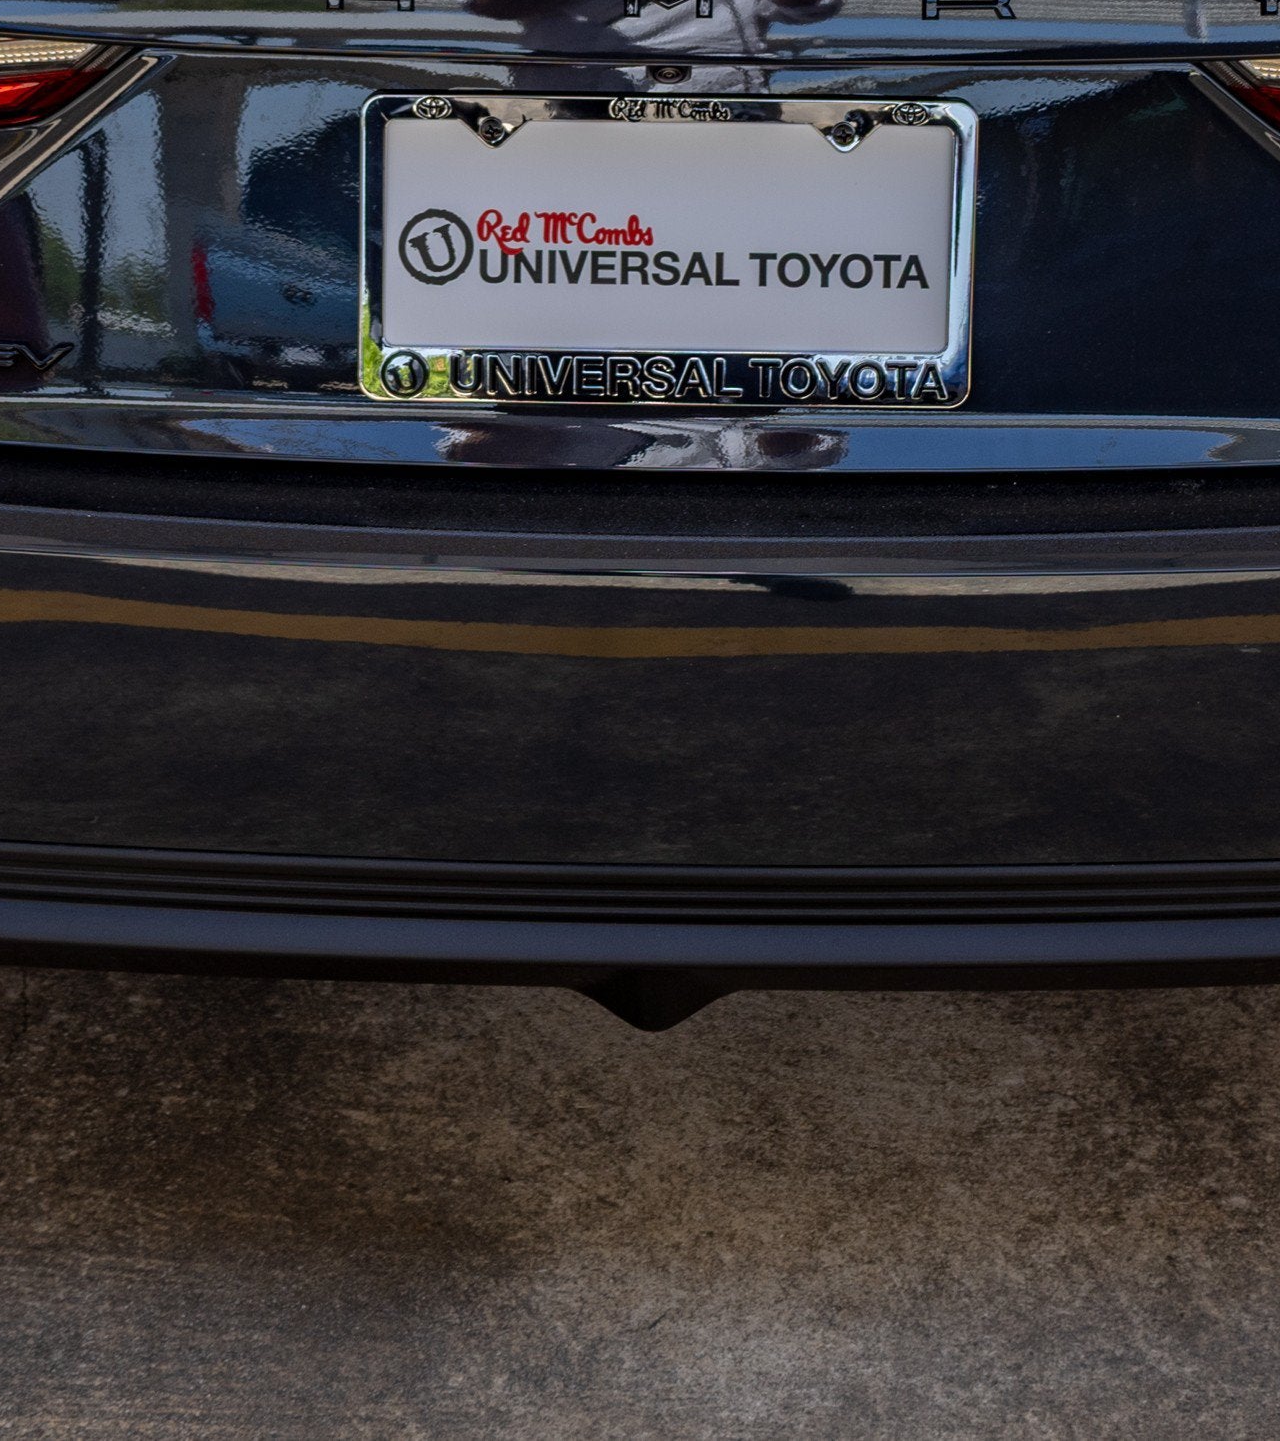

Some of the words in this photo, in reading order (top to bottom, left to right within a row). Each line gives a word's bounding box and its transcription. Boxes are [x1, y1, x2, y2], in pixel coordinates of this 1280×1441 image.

[609, 98, 646, 122] Red
[477, 209, 531, 256] Red
[534, 211, 654, 246] McCombs
[479, 249, 740, 287] UNIVERSAL
[749, 253, 930, 289] TOYOTA
[449, 354, 743, 399] UNIVERSAL
[748, 358, 949, 402] TOYOTA
